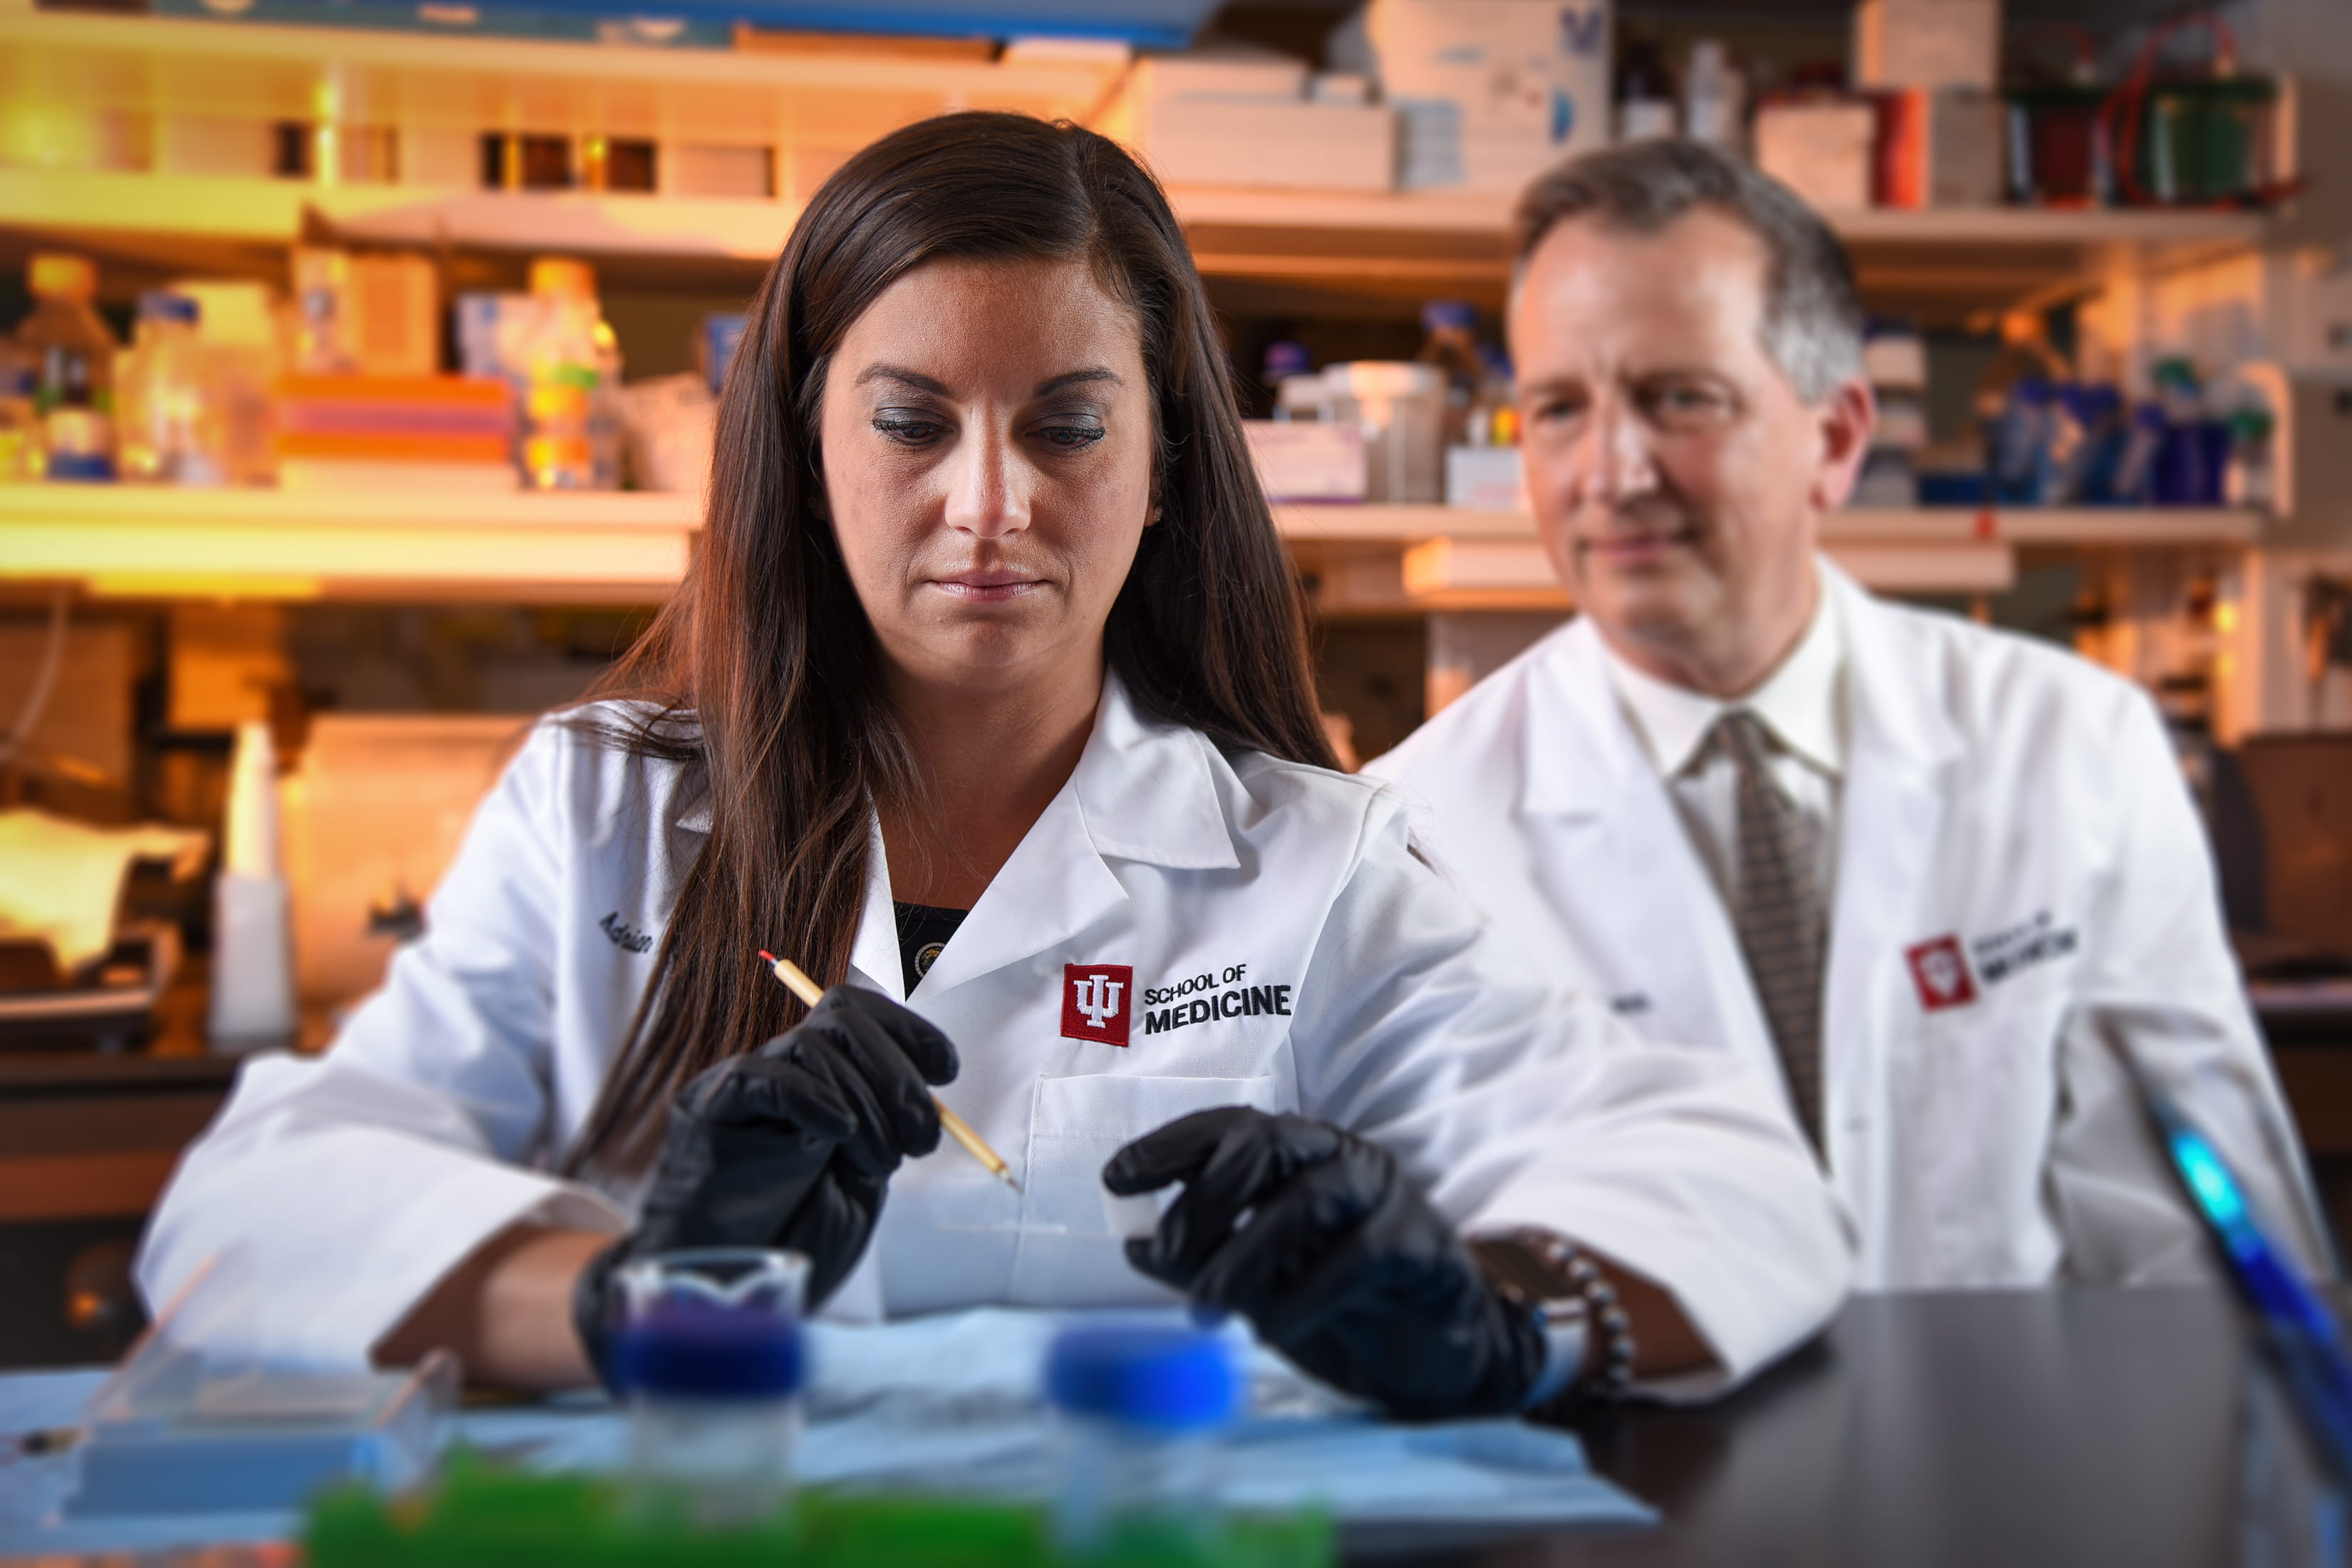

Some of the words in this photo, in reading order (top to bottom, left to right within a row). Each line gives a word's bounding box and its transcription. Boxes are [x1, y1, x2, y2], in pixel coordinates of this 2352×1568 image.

[1144, 972, 1219, 1006] SCHOOL
[1222, 963, 1247, 984] OF
[1145, 984, 1292, 1036] MEDICINE
